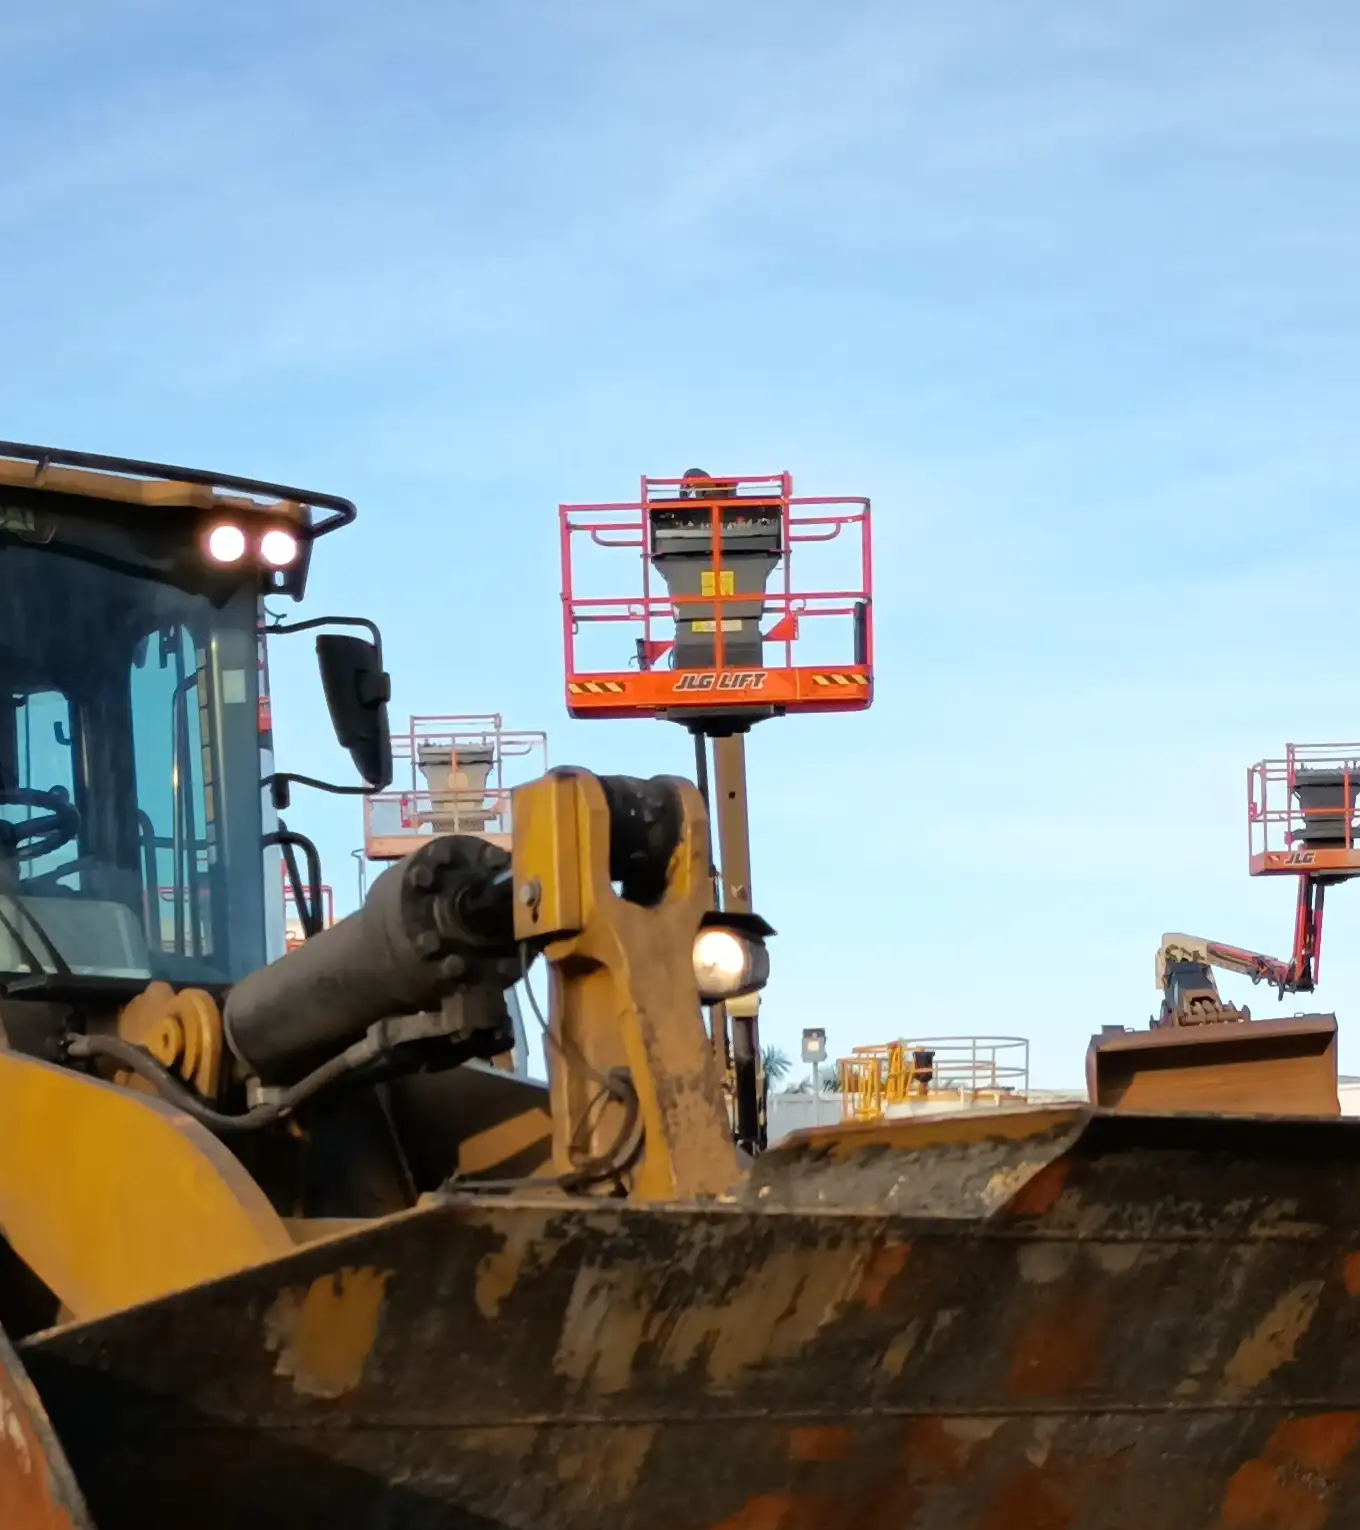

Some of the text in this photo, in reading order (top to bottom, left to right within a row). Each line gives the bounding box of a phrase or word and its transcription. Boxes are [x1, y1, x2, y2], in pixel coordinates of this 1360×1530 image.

[672, 671, 768, 692] JLG LIFT
[1284, 851, 1317, 865] JLG
